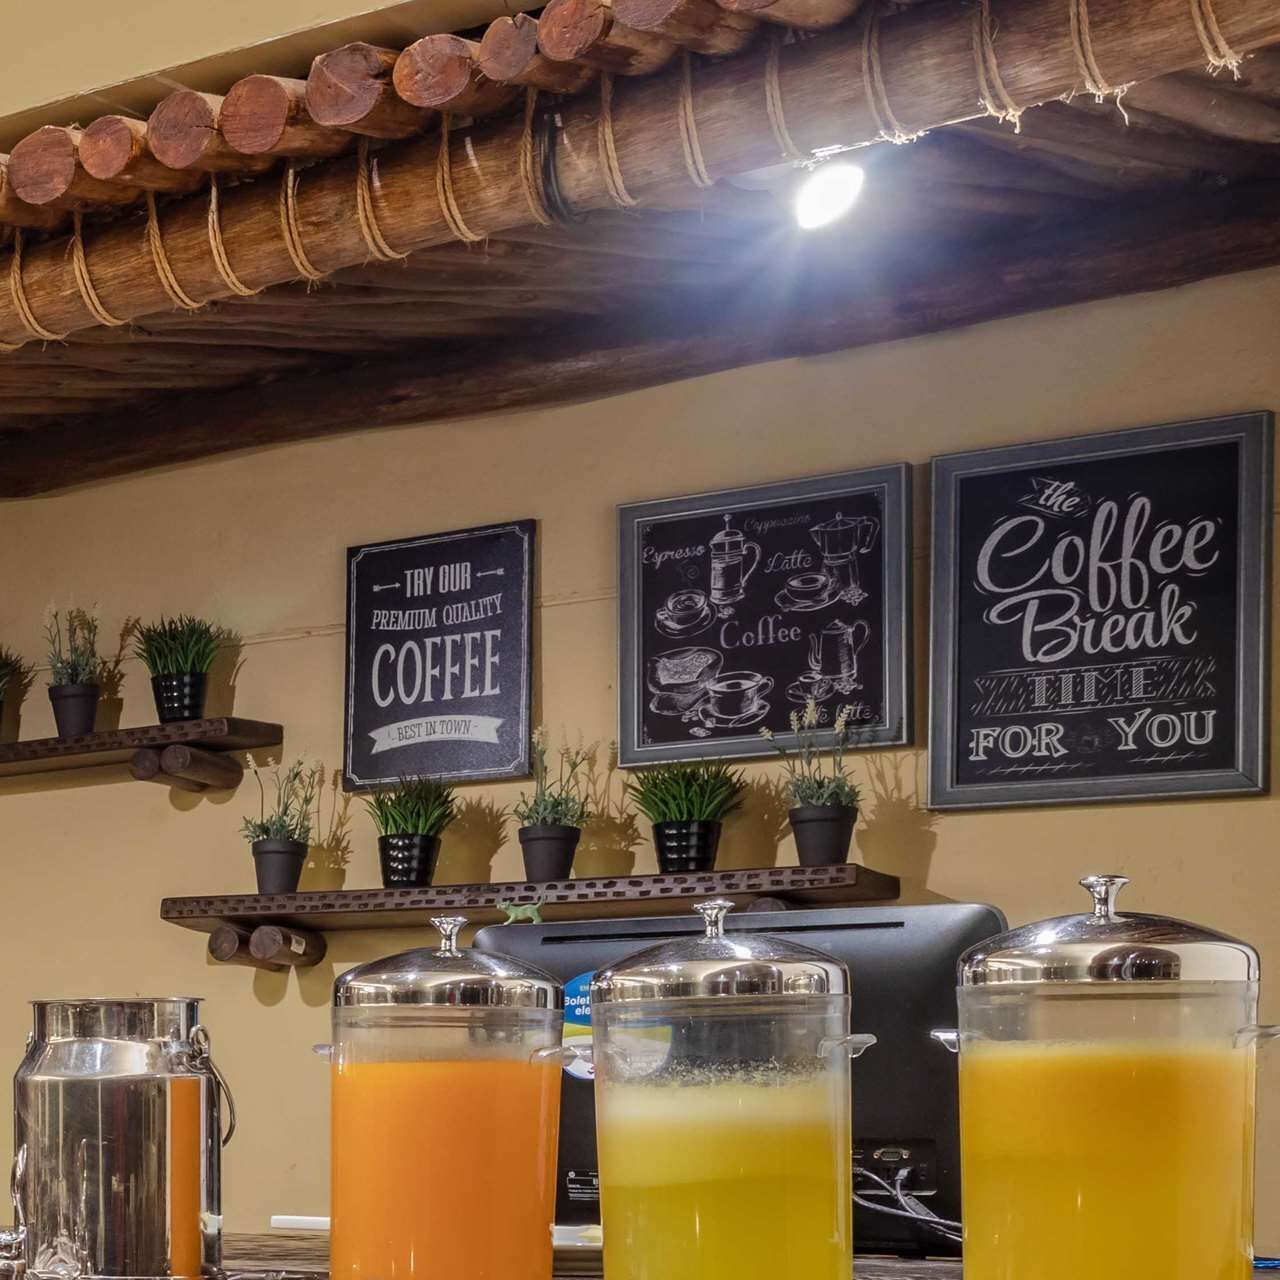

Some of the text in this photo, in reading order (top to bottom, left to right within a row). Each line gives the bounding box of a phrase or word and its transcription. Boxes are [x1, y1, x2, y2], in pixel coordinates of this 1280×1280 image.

[1039, 480, 1081, 512] the
[640, 545, 706, 569] Espresso
[764, 549, 814, 573] Latte
[976, 496, 1220, 612] Coffee
[404, 562, 471, 598] TRY OUR
[370, 593, 503, 630] PREMIUM QUALITY
[989, 584, 1198, 663] Break
[719, 614, 802, 649] Coffee
[371, 629, 502, 707] COFFEE
[1027, 666, 1158, 707] TIME
[397, 719, 472, 741] BEST IN TOWN
[969, 708, 1217, 761] FOR YOU
